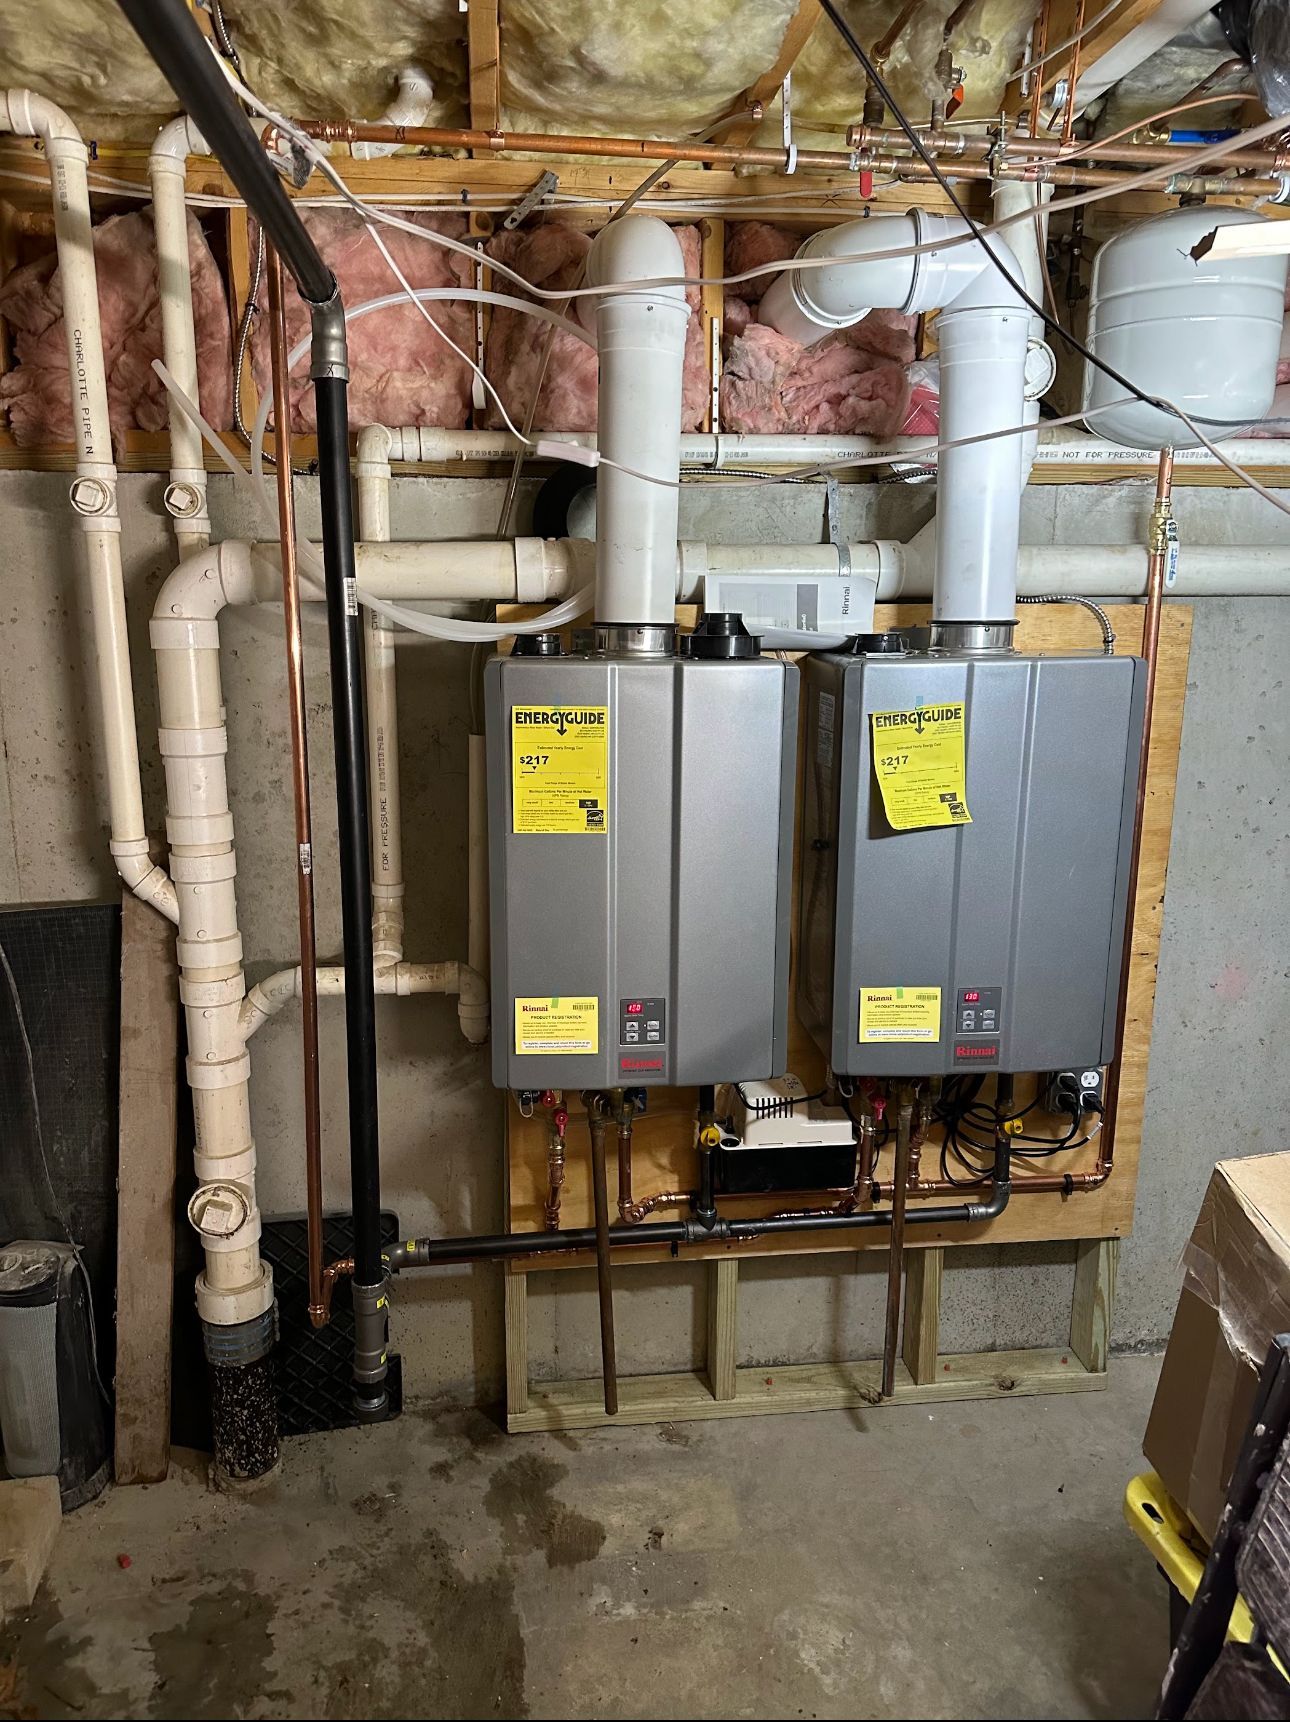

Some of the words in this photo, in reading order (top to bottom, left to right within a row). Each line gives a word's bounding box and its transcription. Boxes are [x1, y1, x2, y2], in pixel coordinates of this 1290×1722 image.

[73, 329, 89, 401] CHARLOTTE
[82, 407, 93, 439] PIPE
[1062, 451, 1081, 459] NOT
[1085, 451, 1103, 459] FOR
[1108, 451, 1154, 459] PRESSURE
[841, 586, 851, 615] Rinnai
[515, 711, 605, 726] ENERGYGUIDE
[875, 707, 962, 728] ENERGYGUIDE
[519, 755, 549, 765] $217
[880, 755, 909, 766] $217
[380, 798, 388, 847] PRESSURE
[382, 852, 390, 871] FOR
[867, 994, 893, 1002] Rinnai
[522, 1004, 549, 1012] Rinnai
[956, 1046, 997, 1057] Rinnai
